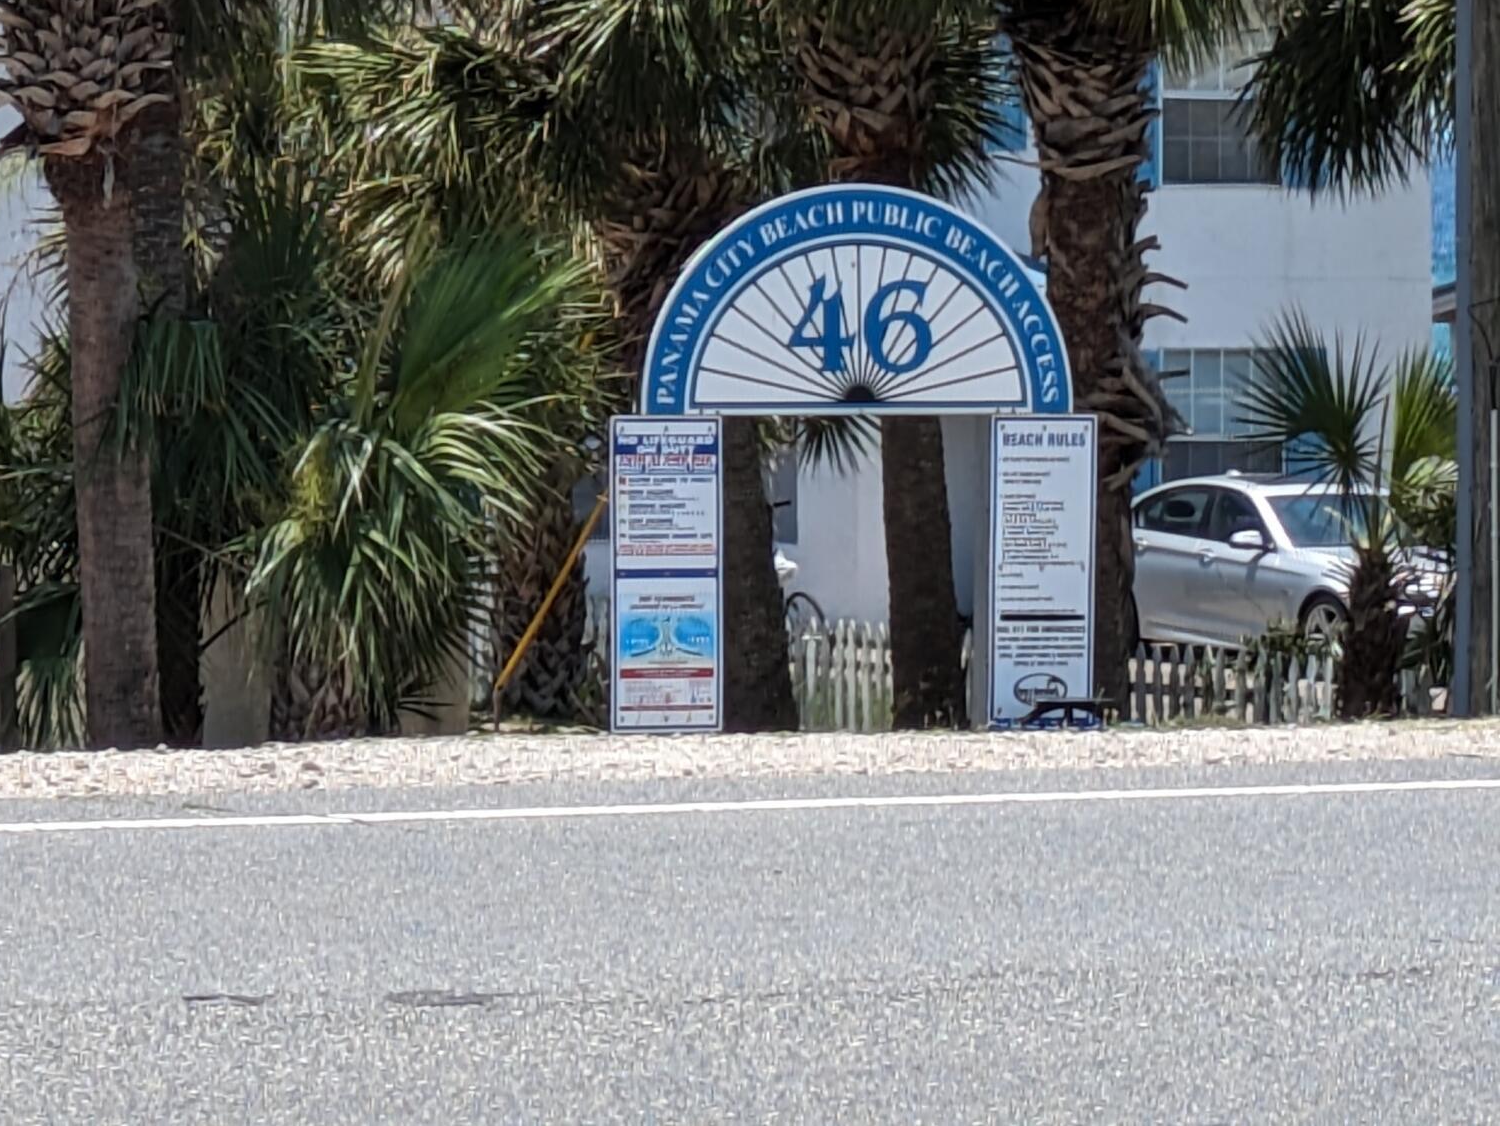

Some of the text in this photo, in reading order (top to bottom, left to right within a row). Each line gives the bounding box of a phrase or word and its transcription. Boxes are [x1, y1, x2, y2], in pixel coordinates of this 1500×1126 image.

[656, 200, 1059, 404] PANAMA CITY BEACH PUBLIC BEACH ACCESS
[787, 272, 932, 374] 46
[1002, 433, 1086, 447] BEACH RULES
